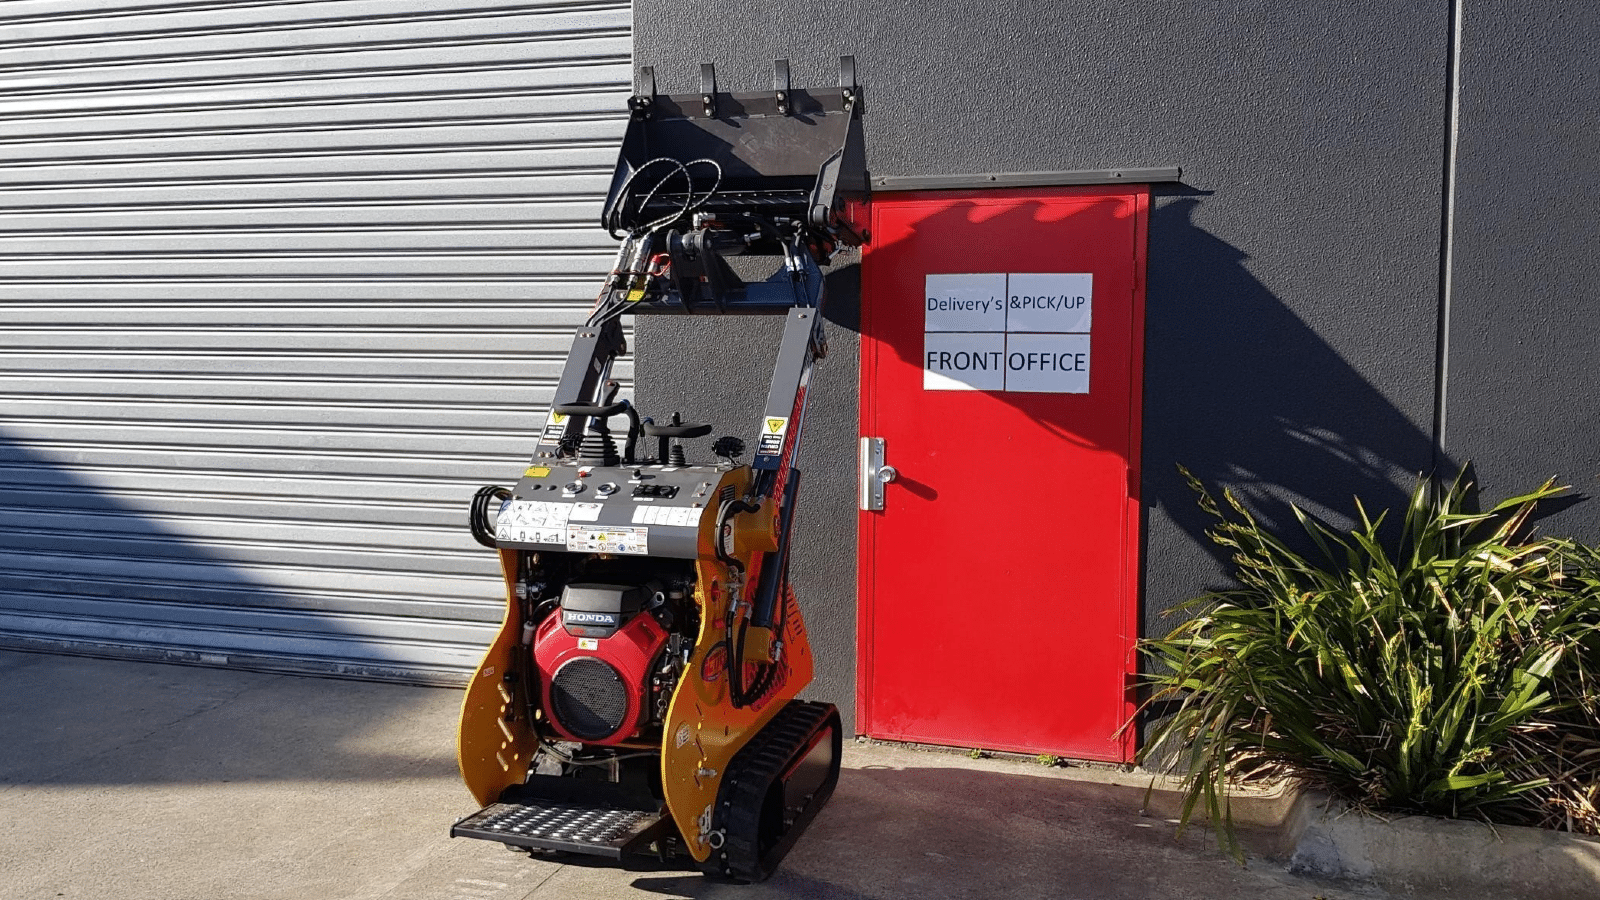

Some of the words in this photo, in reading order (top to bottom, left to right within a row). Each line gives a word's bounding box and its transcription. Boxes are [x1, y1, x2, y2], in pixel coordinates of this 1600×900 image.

[927, 296, 1003, 314] Delivery's
[1009, 295, 1085, 311] &PICK/UP
[927, 351, 1003, 371] FRONT
[1008, 352, 1086, 372] OFFICE
[567, 613, 614, 623] HONDA
